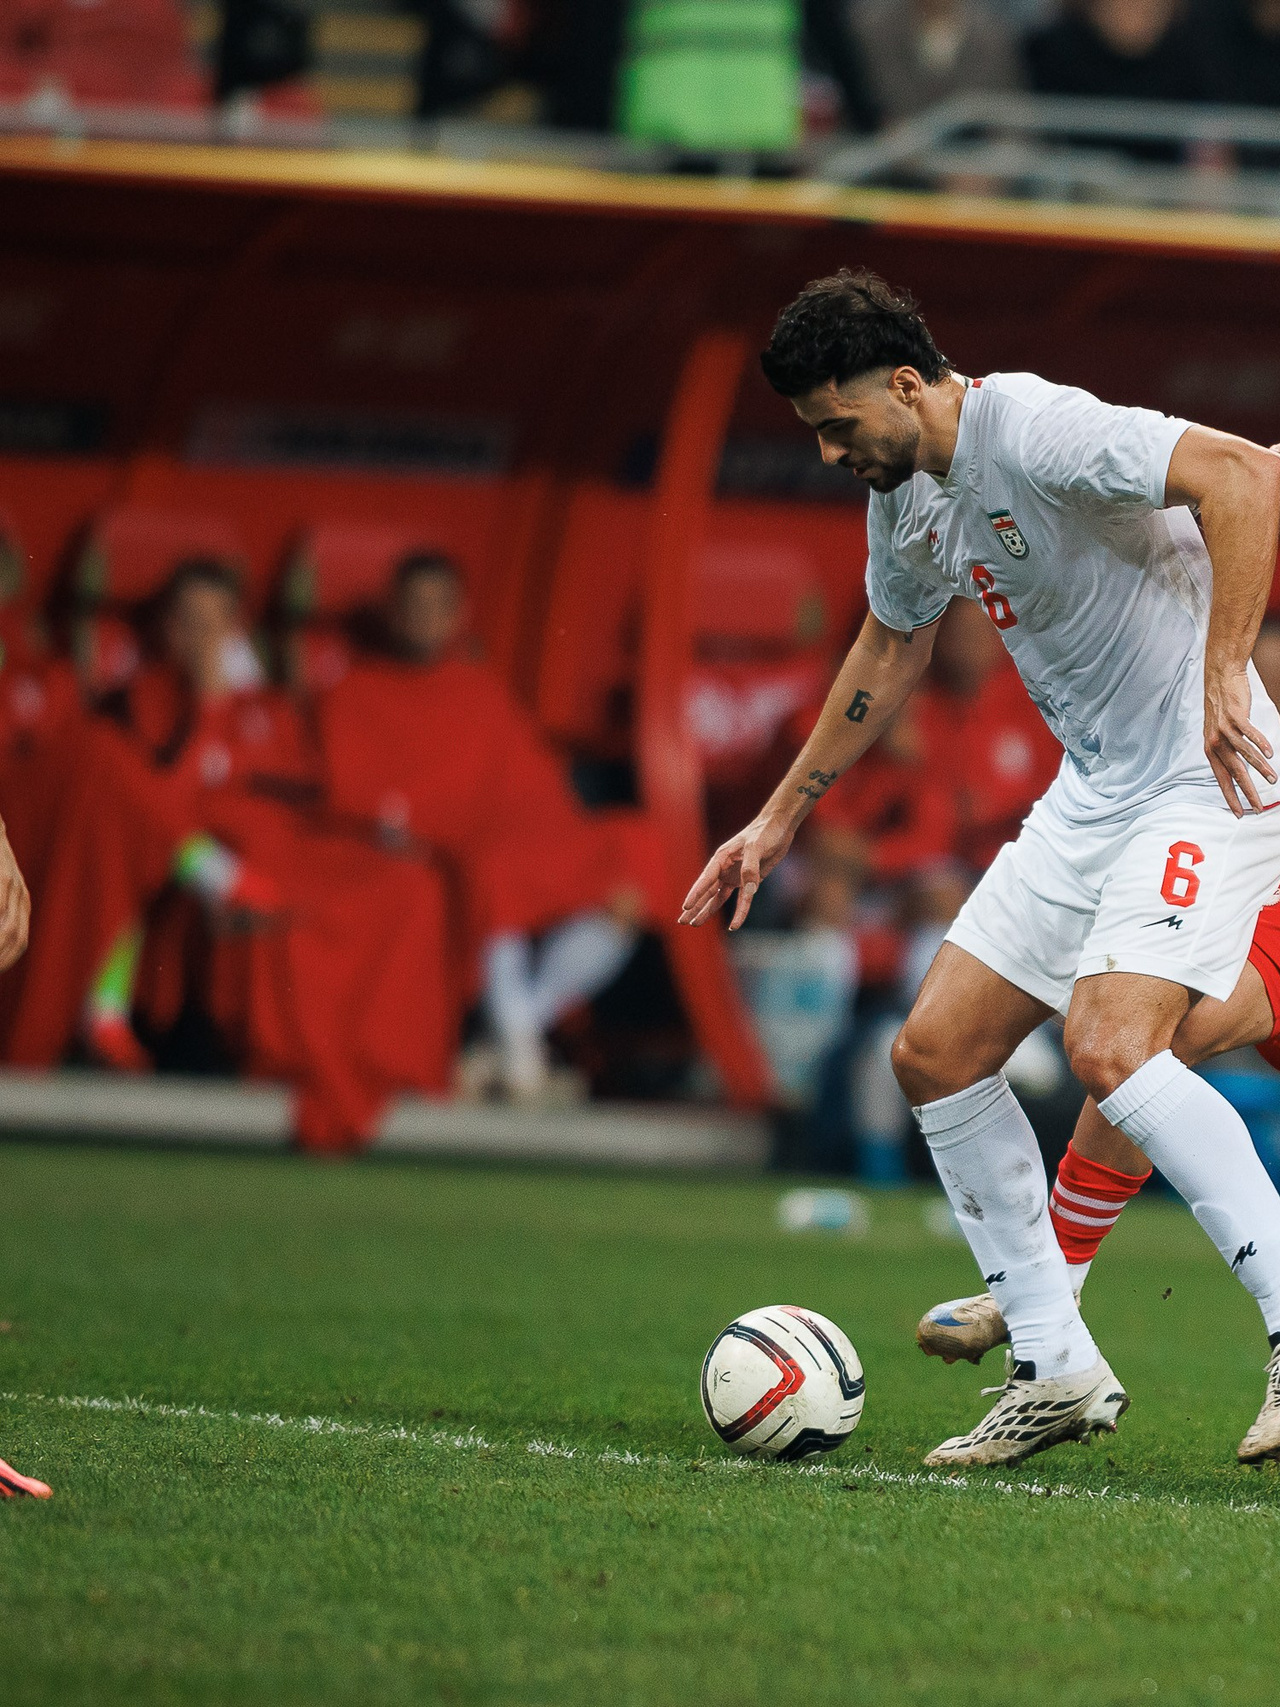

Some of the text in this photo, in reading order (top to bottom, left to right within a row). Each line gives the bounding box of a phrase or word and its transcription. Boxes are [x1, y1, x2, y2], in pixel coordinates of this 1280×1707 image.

[971, 565, 1019, 631] 6
[845, 689, 875, 723] 6
[1160, 840, 1206, 908] 6
